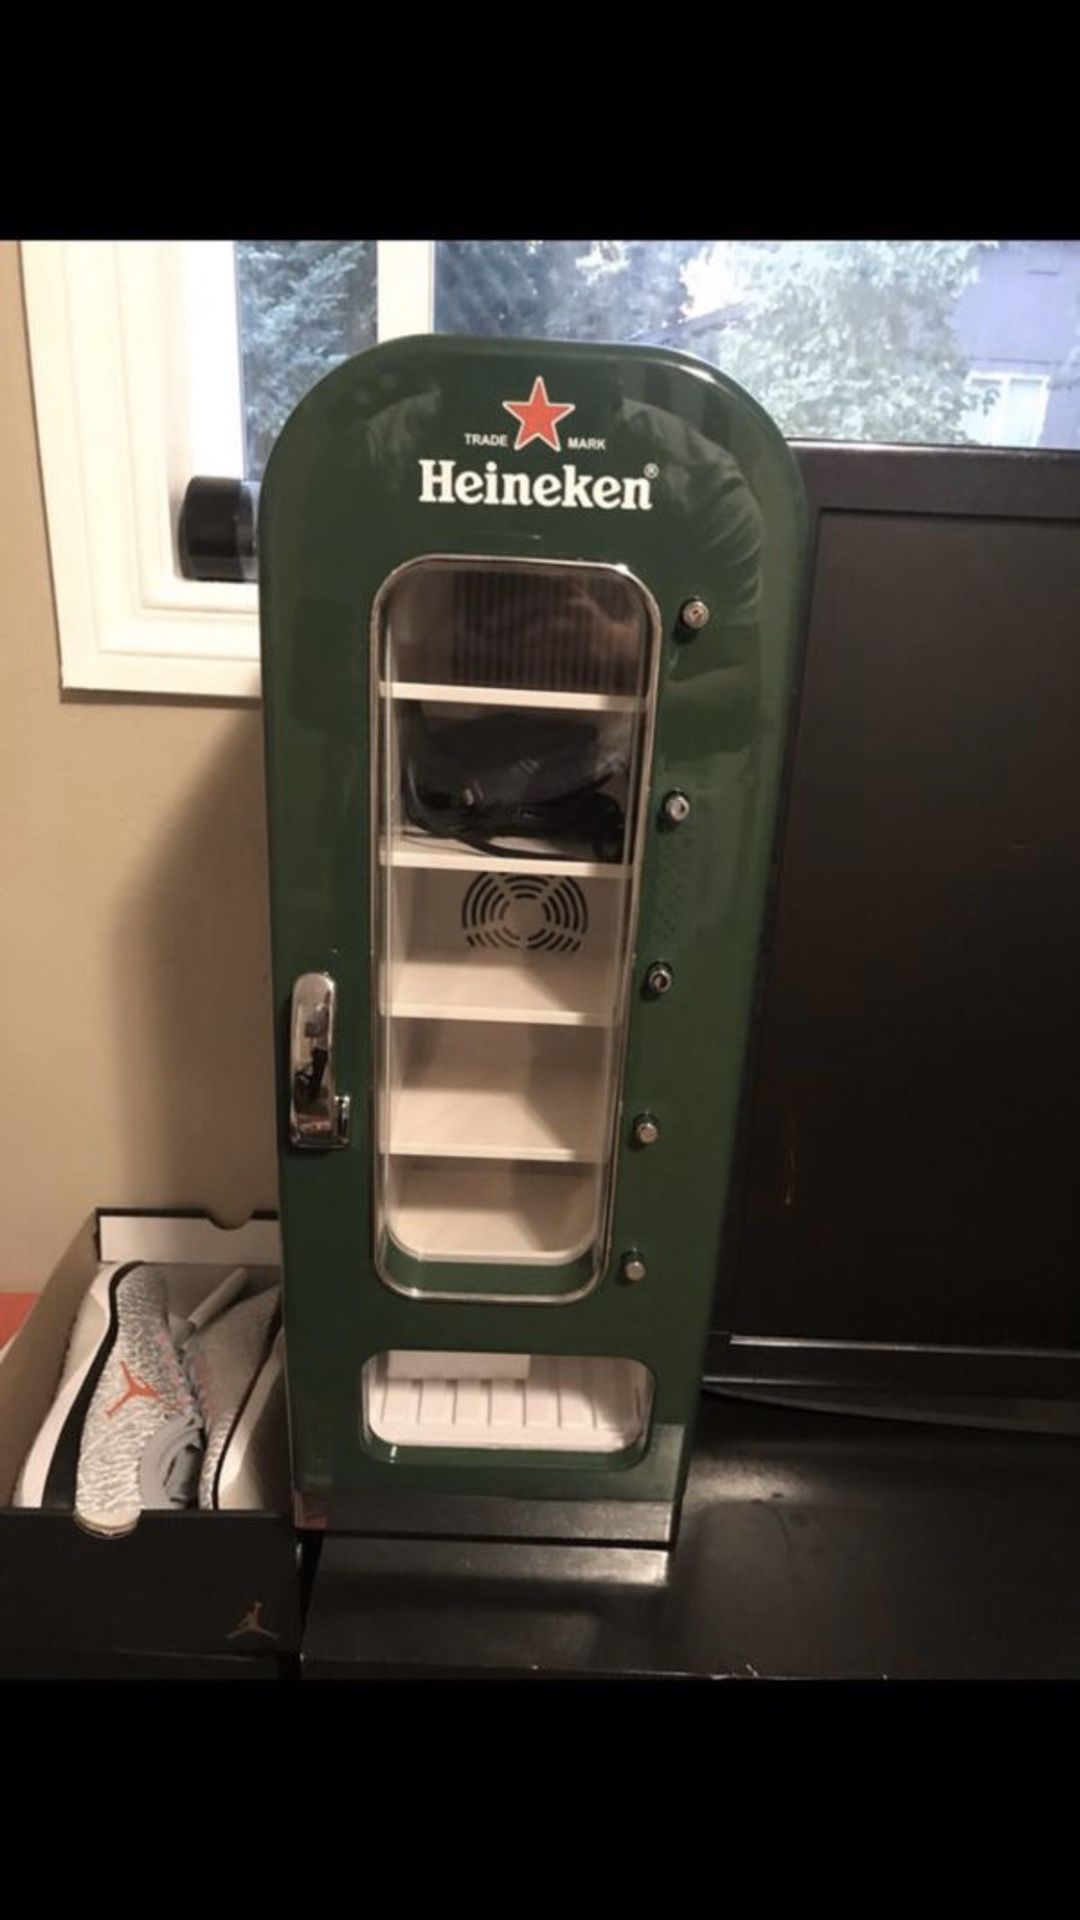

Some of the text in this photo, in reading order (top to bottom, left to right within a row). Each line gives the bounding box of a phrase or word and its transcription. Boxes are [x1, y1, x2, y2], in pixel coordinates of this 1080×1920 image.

[464, 432, 606, 450] TRADE MARK
[418, 459, 653, 510] Heineken
